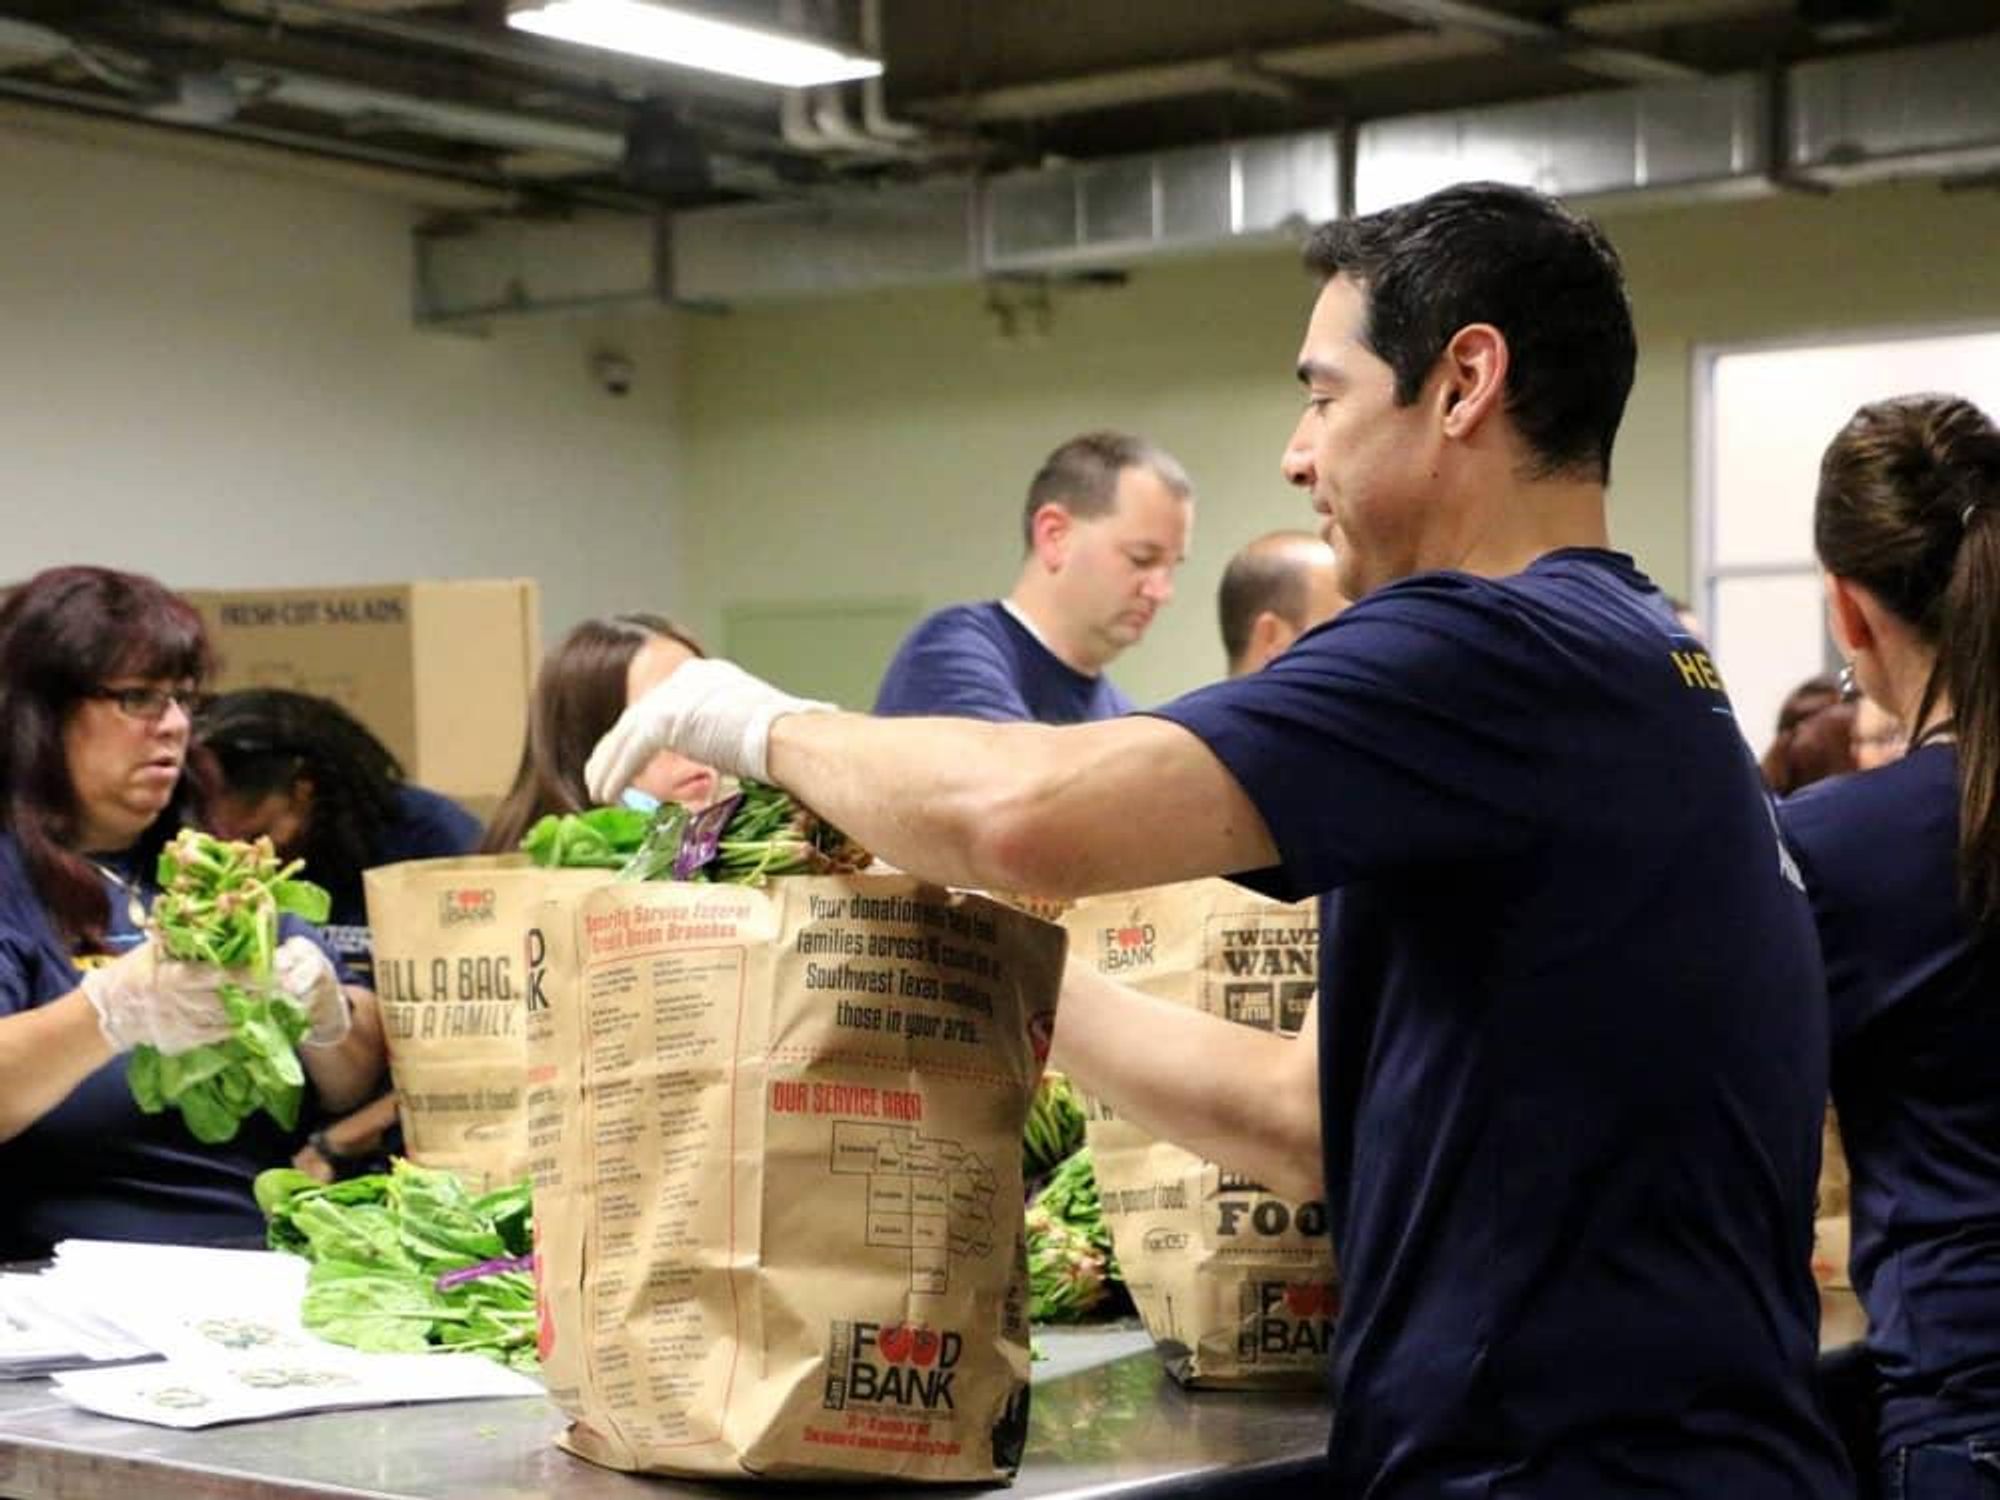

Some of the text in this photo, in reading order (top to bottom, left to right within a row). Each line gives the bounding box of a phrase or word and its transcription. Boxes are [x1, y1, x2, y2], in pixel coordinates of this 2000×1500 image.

[809, 895, 843, 920] Your
[431, 957, 448, 1002] A
[806, 963, 894, 994] Southwest
[421, 1004, 436, 1040] A
[837, 1003, 882, 1029] those
[886, 1006, 901, 1032] in
[904, 1012, 941, 1040] your
[772, 1081, 922, 1121] OUR SERVICE AREA
[849, 1363, 956, 1410] BANK
